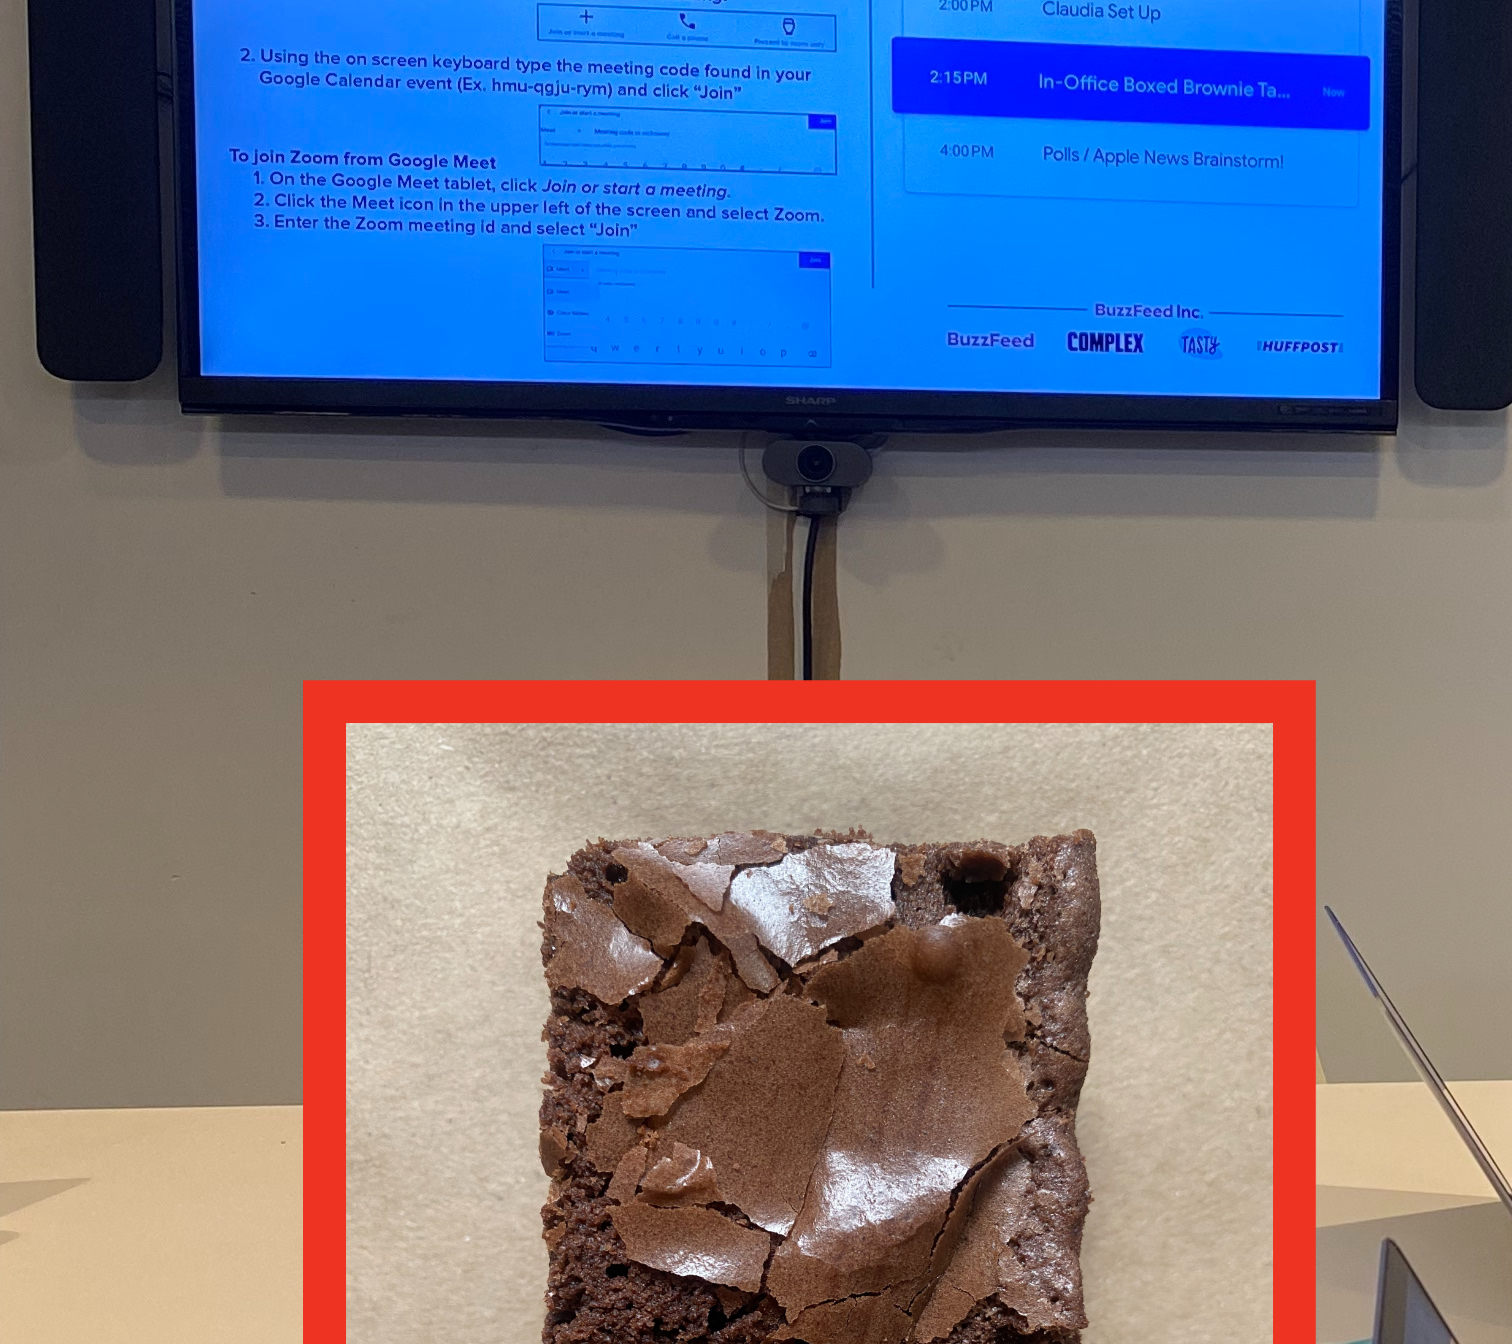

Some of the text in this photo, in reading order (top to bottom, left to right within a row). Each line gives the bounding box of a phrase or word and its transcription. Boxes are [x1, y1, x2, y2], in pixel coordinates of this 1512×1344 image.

[1042, 0, 1104, 18] Claudia
[1107, 2, 1135, 19] Set
[1138, 3, 1161, 24] Up
[258, 69, 741, 100] Google Calendar event (Ex. hmu-qgju-rym) and click “Join”
[1038, 72, 1119, 92] In-Office
[1123, 75, 1178, 94] Boxed
[1183, 78, 1254, 97] Brownie
[1256, 81, 1290, 98] Ta...
[1322, 86, 1345, 98] Now
[228, 147, 496, 170] To join Zoom from Google Meet
[1043, 145, 1080, 162] Polls
[1092, 147, 1140, 167] Apple
[1143, 148, 1189, 166] News
[1193, 150, 1283, 168] Brainstorm!
[253, 213, 637, 237] 3. Enter the Zoom meeting id and select “Join”
[1094, 303, 1204, 319] BuzzFeed Inc.
[947, 332, 1035, 348] BuzzFeed
[1067, 331, 1144, 354] COMPLEX
[1262, 340, 1339, 354] HUFFPOST
[784, 395, 837, 406] SHARP
